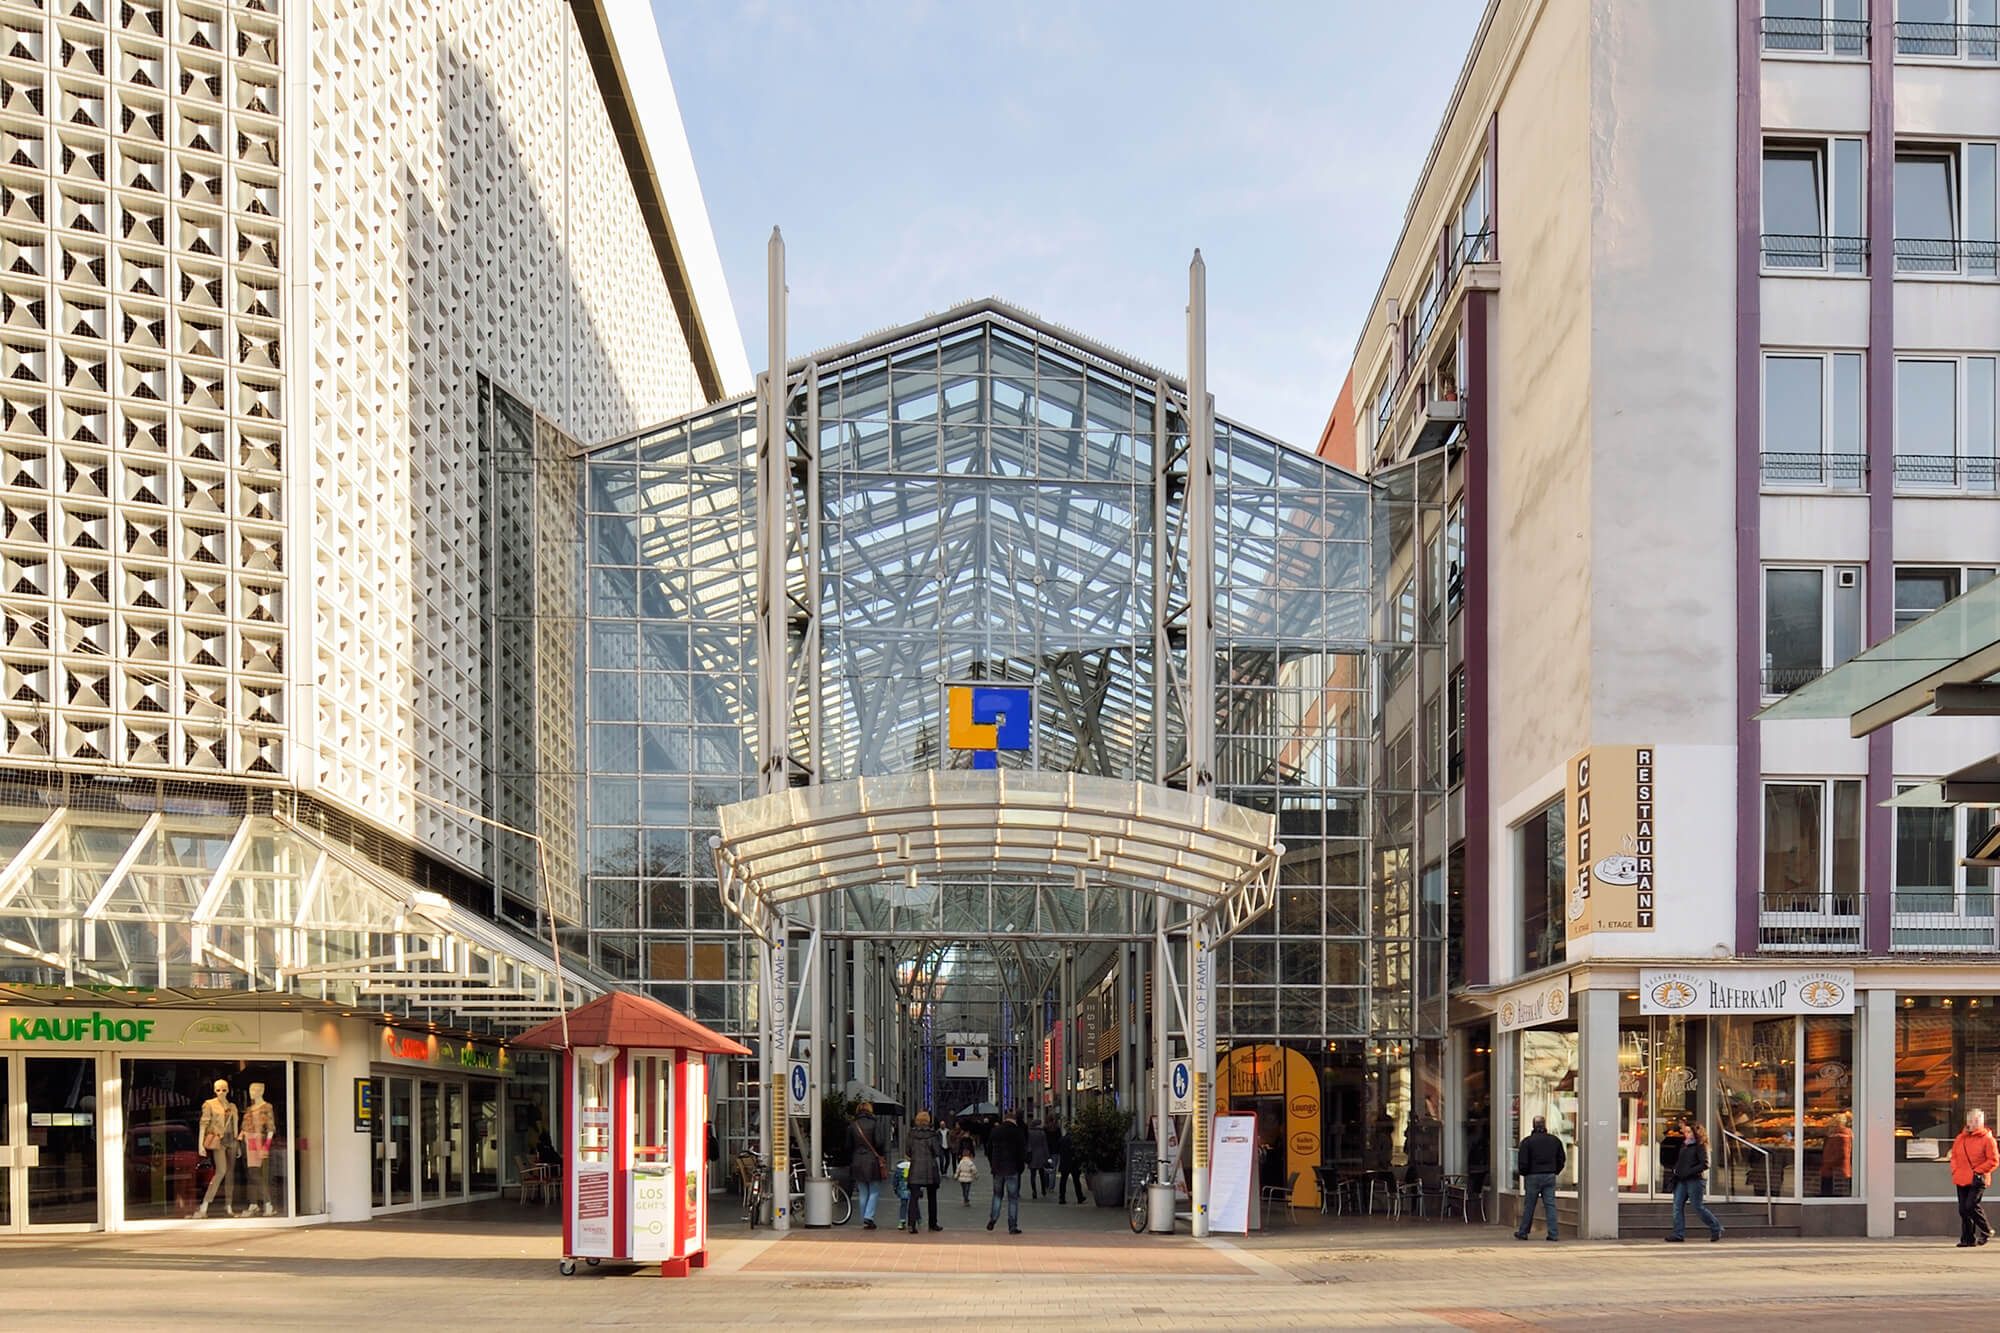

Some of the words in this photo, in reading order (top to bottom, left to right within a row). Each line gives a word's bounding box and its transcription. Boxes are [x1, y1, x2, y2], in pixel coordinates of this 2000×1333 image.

[1578, 759, 1589, 898] CAFÉ
[1639, 751, 1651, 926] RESTAURANT
[1597, 920, 1606, 928] 1.
[775, 956, 785, 990] FAME
[1196, 957, 1207, 992] FAME
[775, 998, 785, 1013] OF
[1196, 997, 1207, 1014] OF
[1709, 979, 1787, 1009] HAFERKAMP
[775, 1019, 785, 1050] MALL
[1087, 1004, 1096, 1055] ESPRIT
[1197, 1018, 1208, 1049] MALL
[1292, 1103, 1317, 1113] Lounge
[639, 1188, 664, 1199] LOS
